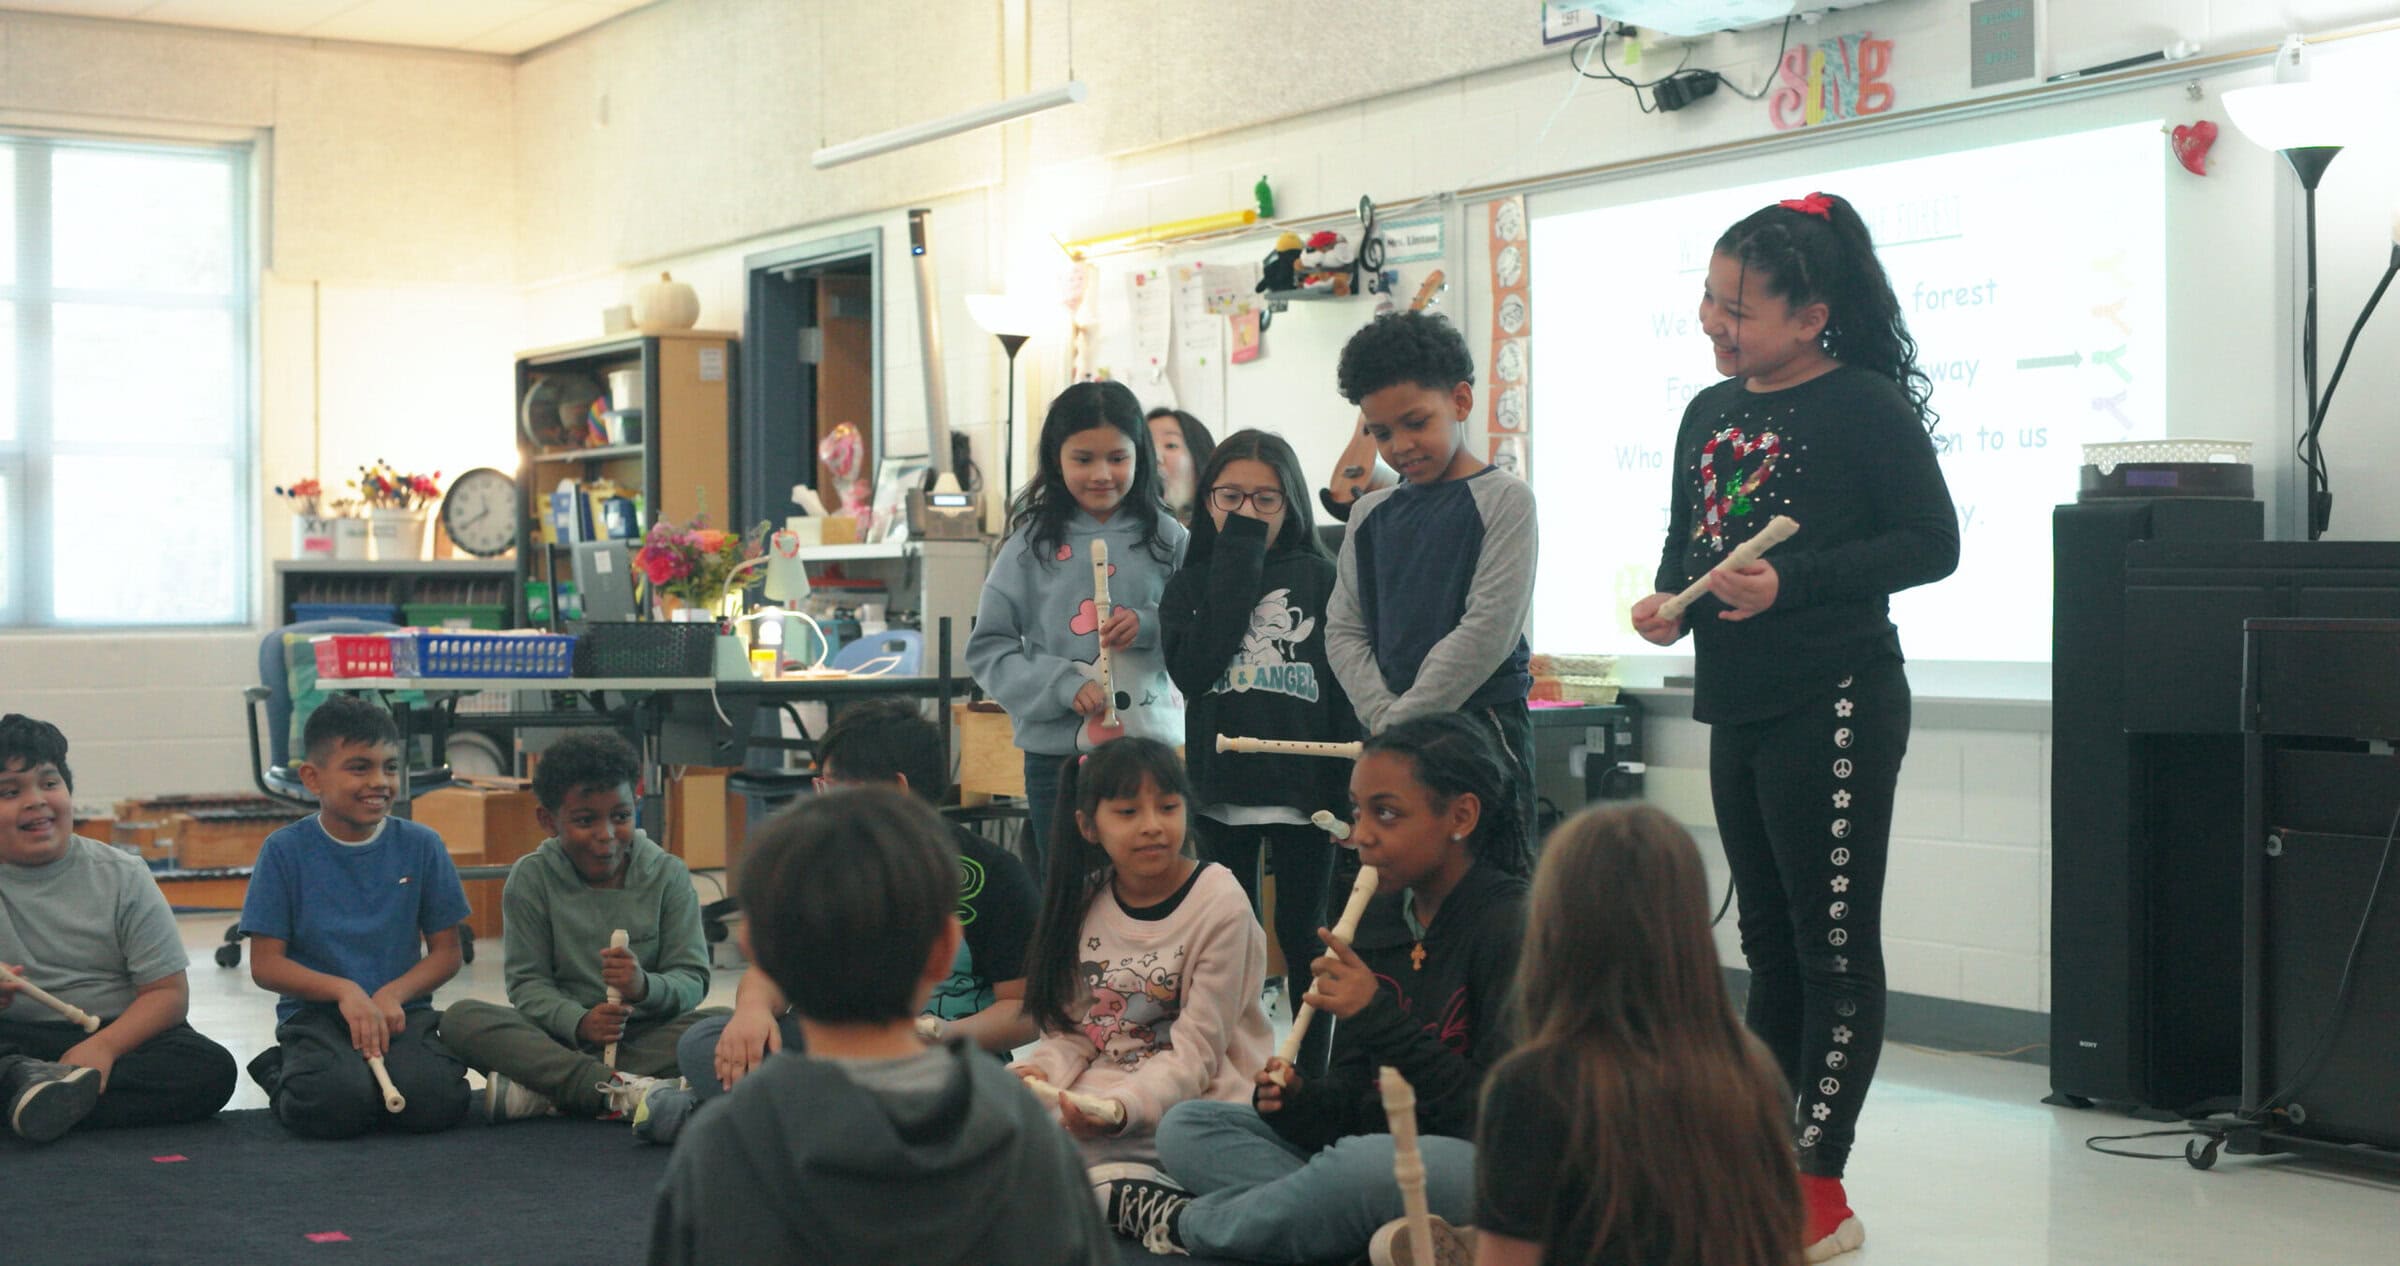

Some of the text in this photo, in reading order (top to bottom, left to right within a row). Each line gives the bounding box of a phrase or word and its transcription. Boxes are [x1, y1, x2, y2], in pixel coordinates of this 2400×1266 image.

[1912, 278, 1998, 313] forest
[1615, 443, 1663, 470] Who
[1977, 424, 2004, 452] to
[2018, 427, 2048, 450] us
[1252, 663, 1319, 702] ANGEL
